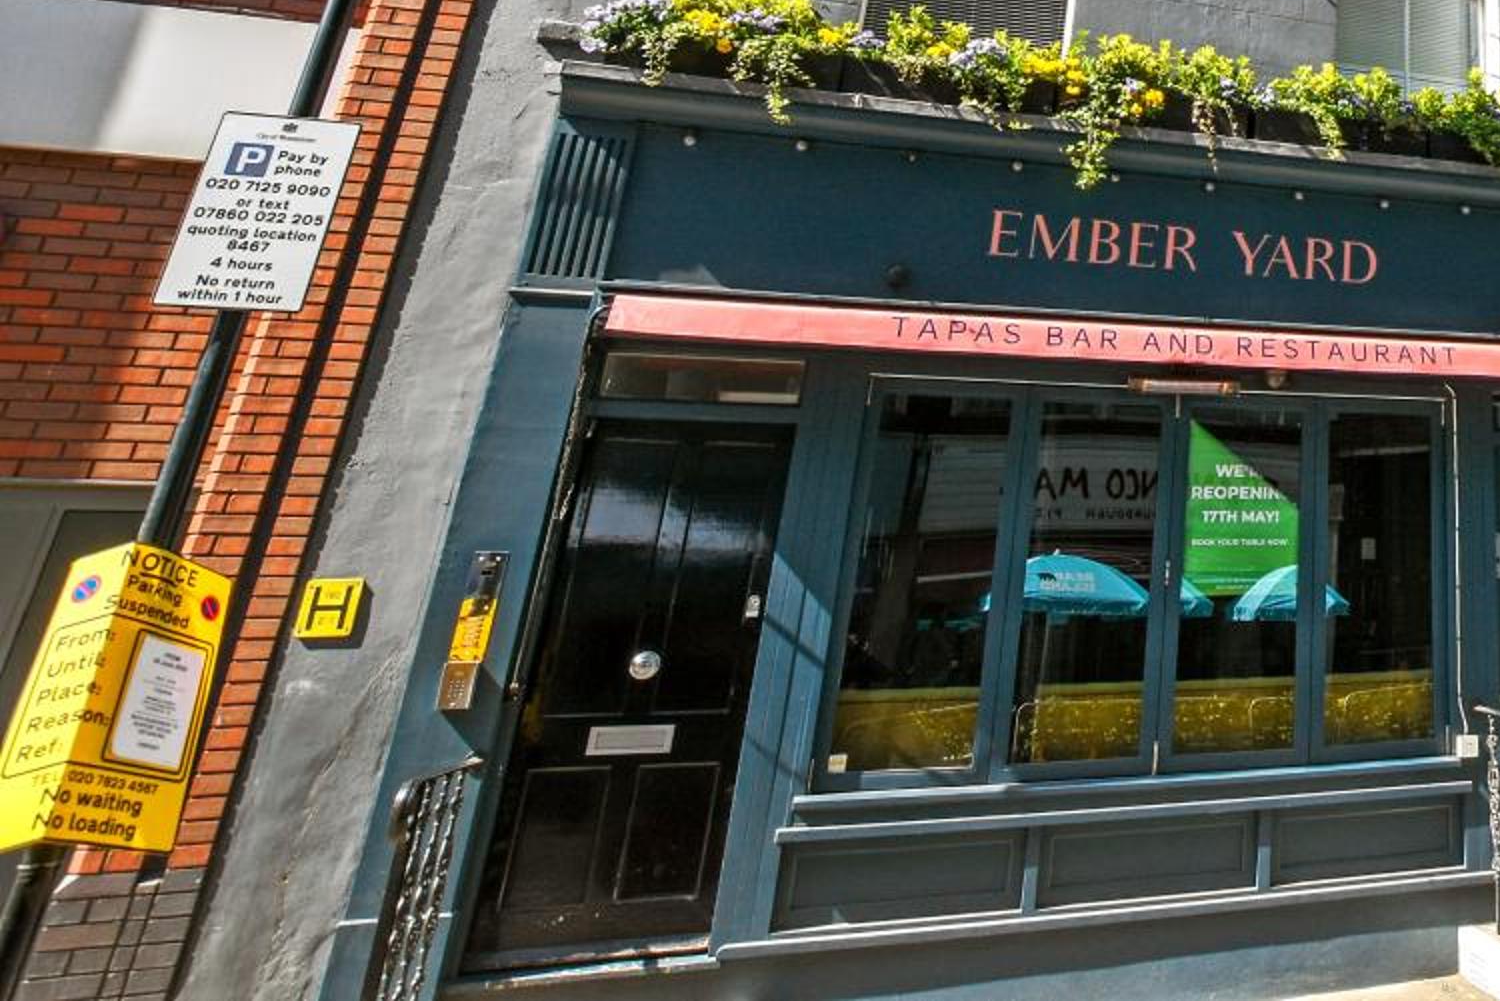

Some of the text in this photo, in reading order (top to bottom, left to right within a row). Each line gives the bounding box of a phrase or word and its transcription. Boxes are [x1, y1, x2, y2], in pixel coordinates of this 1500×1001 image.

[235, 146, 267, 173] P
[277, 150, 330, 166] Pay by
[274, 165, 321, 177] phone
[205, 178, 331, 197] 020 7125 9090
[235, 199, 290, 210] or text
[193, 207, 324, 226] 07860 022 205
[187, 224, 317, 242] quoting location
[226, 240, 271, 252] 8467
[987, 208, 1379, 285] EMBER YARD
[209, 257, 273, 271] 4 hours
[195, 274, 276, 290] No return
[177, 288, 284, 304] within 1 hour
[892, 316, 1457, 365] TAPAS BAR AND RESTAURANT
[1191, 486, 1286, 499] REOPENIN
[1202, 510, 1280, 523] 17TH MAY!
[121, 550, 199, 588] NOTICE
[127, 574, 183, 607] Parking
[103, 594, 190, 629] Suspended
[306, 586, 353, 630] H
[67, 770, 95, 784] 020
[40, 785, 143, 818] No waiting
[32, 810, 137, 842] No loading
